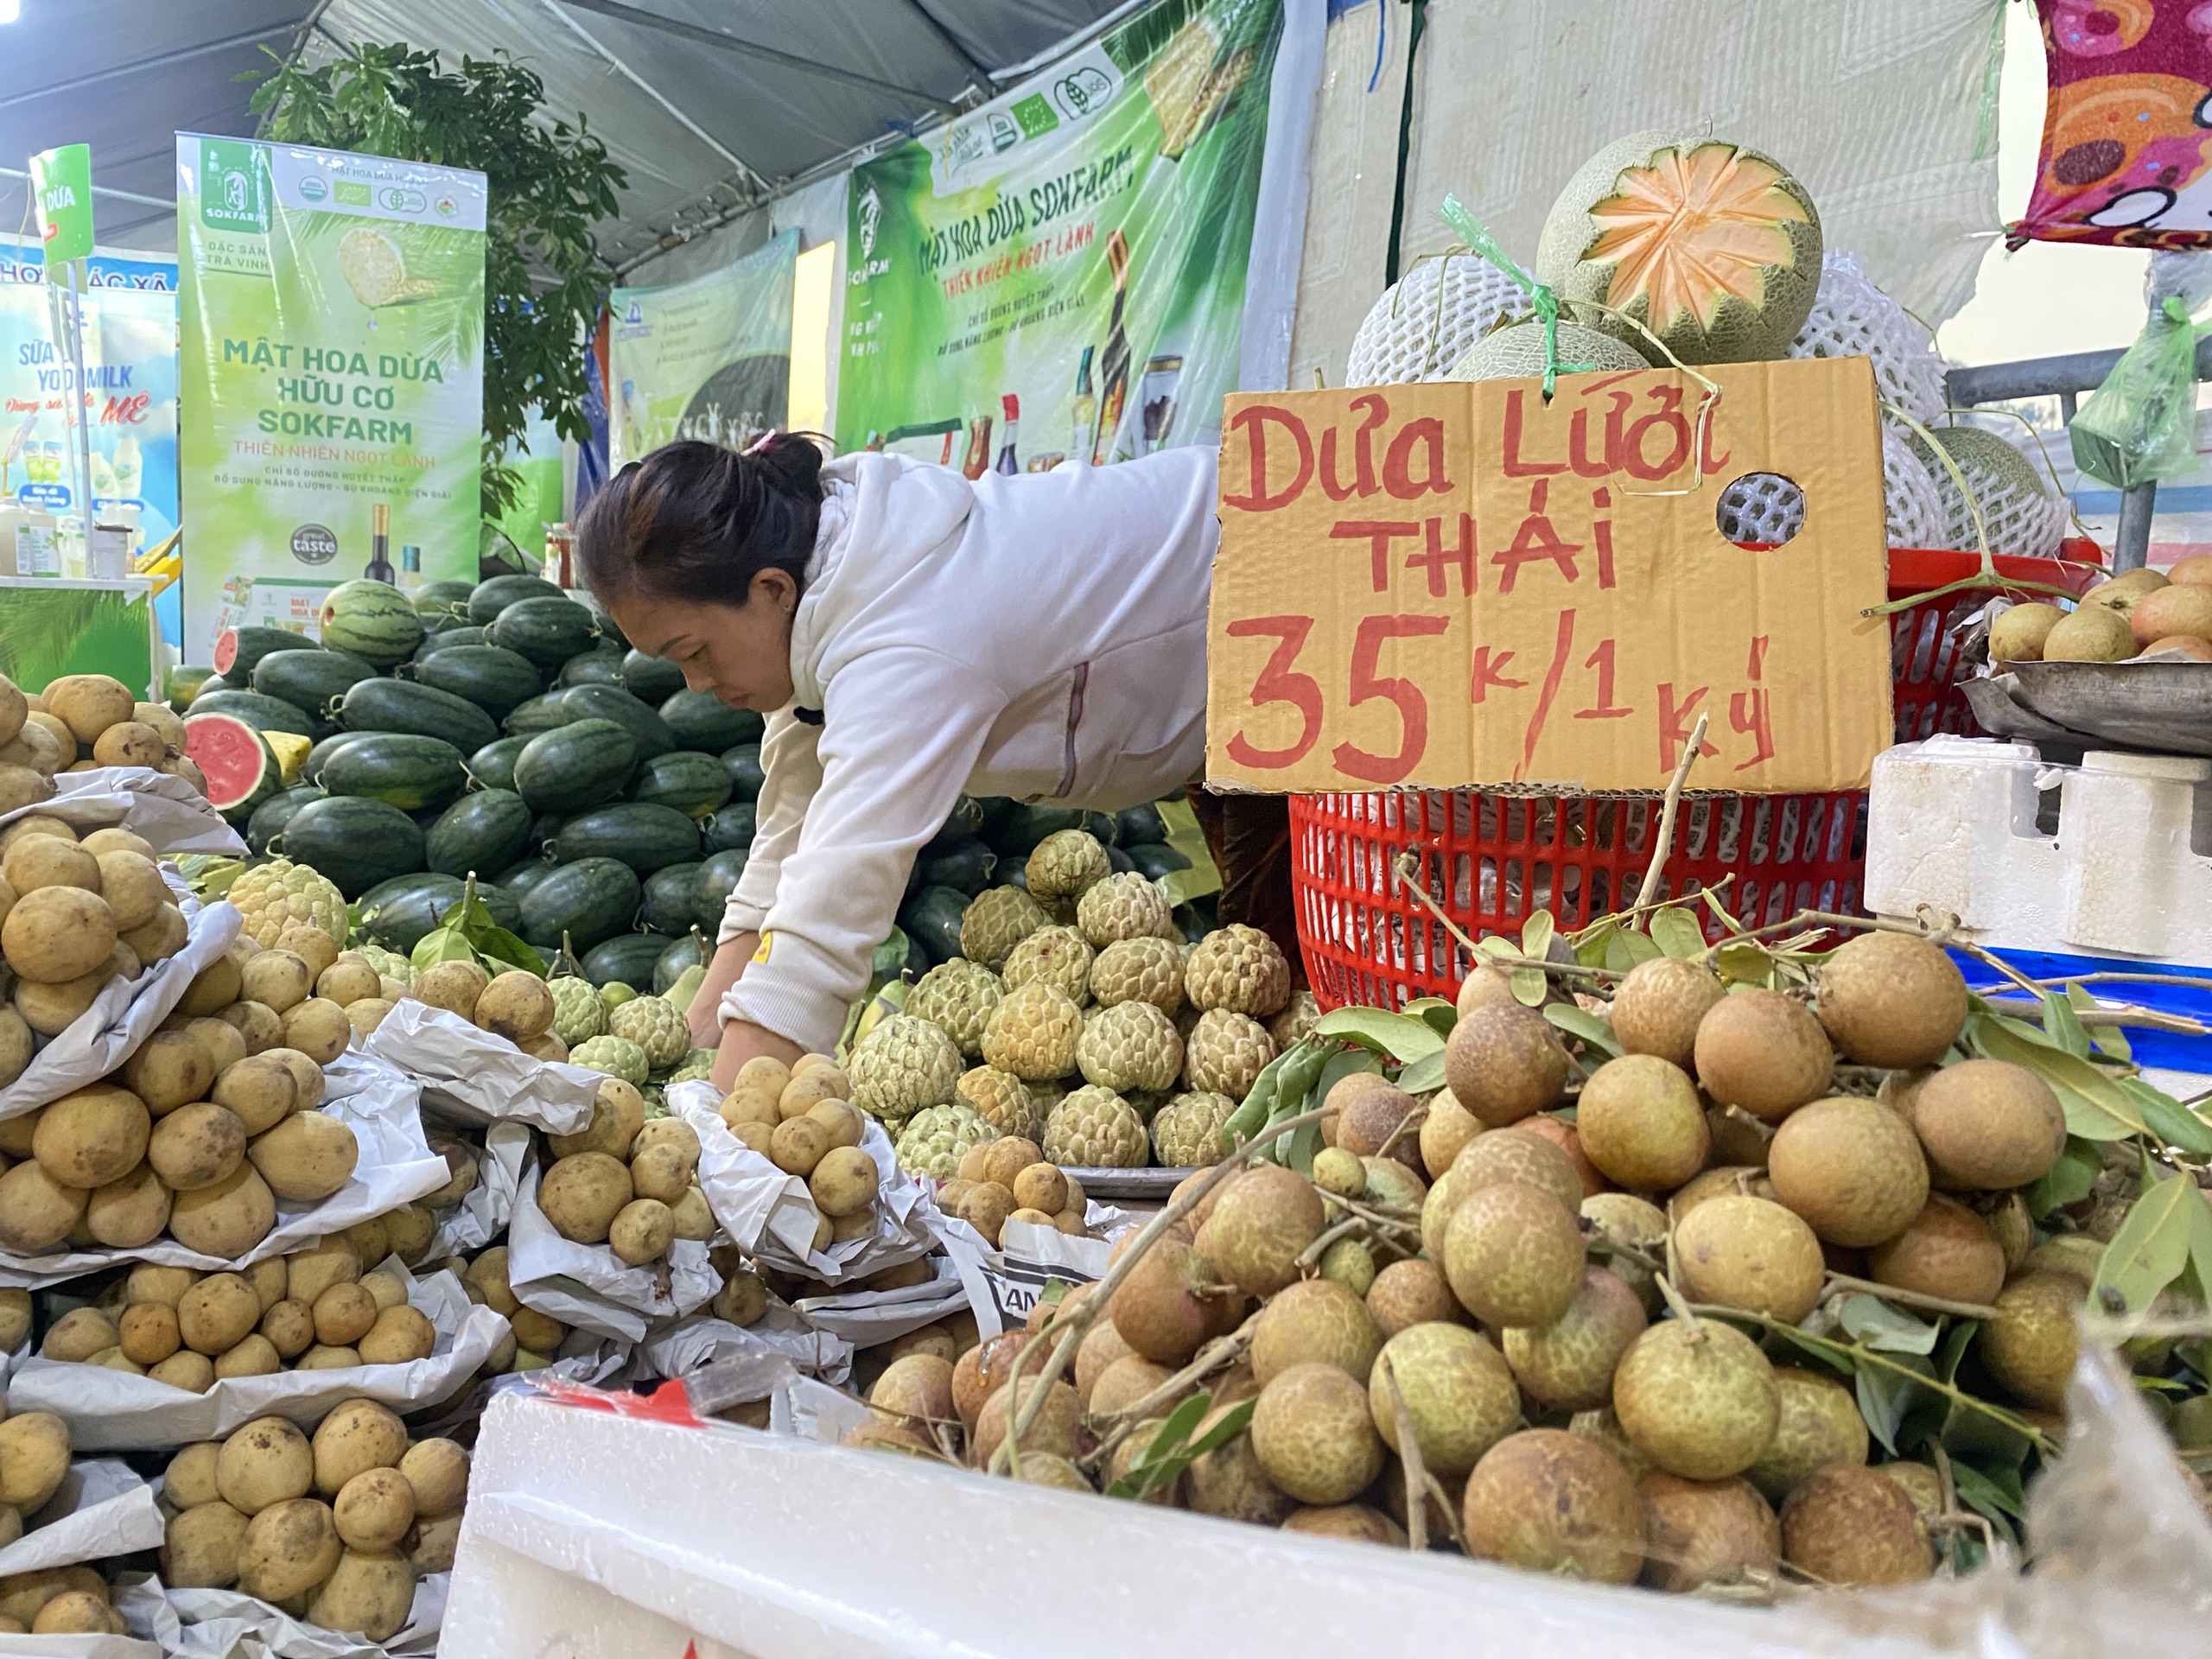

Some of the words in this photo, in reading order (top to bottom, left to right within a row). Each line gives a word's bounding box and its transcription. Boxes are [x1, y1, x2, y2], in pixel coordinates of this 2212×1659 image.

[46, 184, 76, 212] DỪA
[950, 215, 984, 262] HOA
[987, 193, 1026, 246] DỪA
[237, 257, 270, 270] VINH
[18, 338, 54, 365] SỮA
[223, 335, 295, 374] MẬT
[302, 347, 370, 376] HOA
[378, 347, 445, 384] DỪA
[277, 374, 344, 407] HỮU
[353, 385, 396, 411] CƠ
[257, 408, 413, 446] SOKFARM
[233, 439, 285, 457] THIÊN
[289, 444, 340, 461] NHIÊN
[344, 449, 388, 465] NGỌT
[391, 451, 436, 468] LÀNH
[292, 538, 336, 554] taste
[1224, 614, 1451, 785] 35
